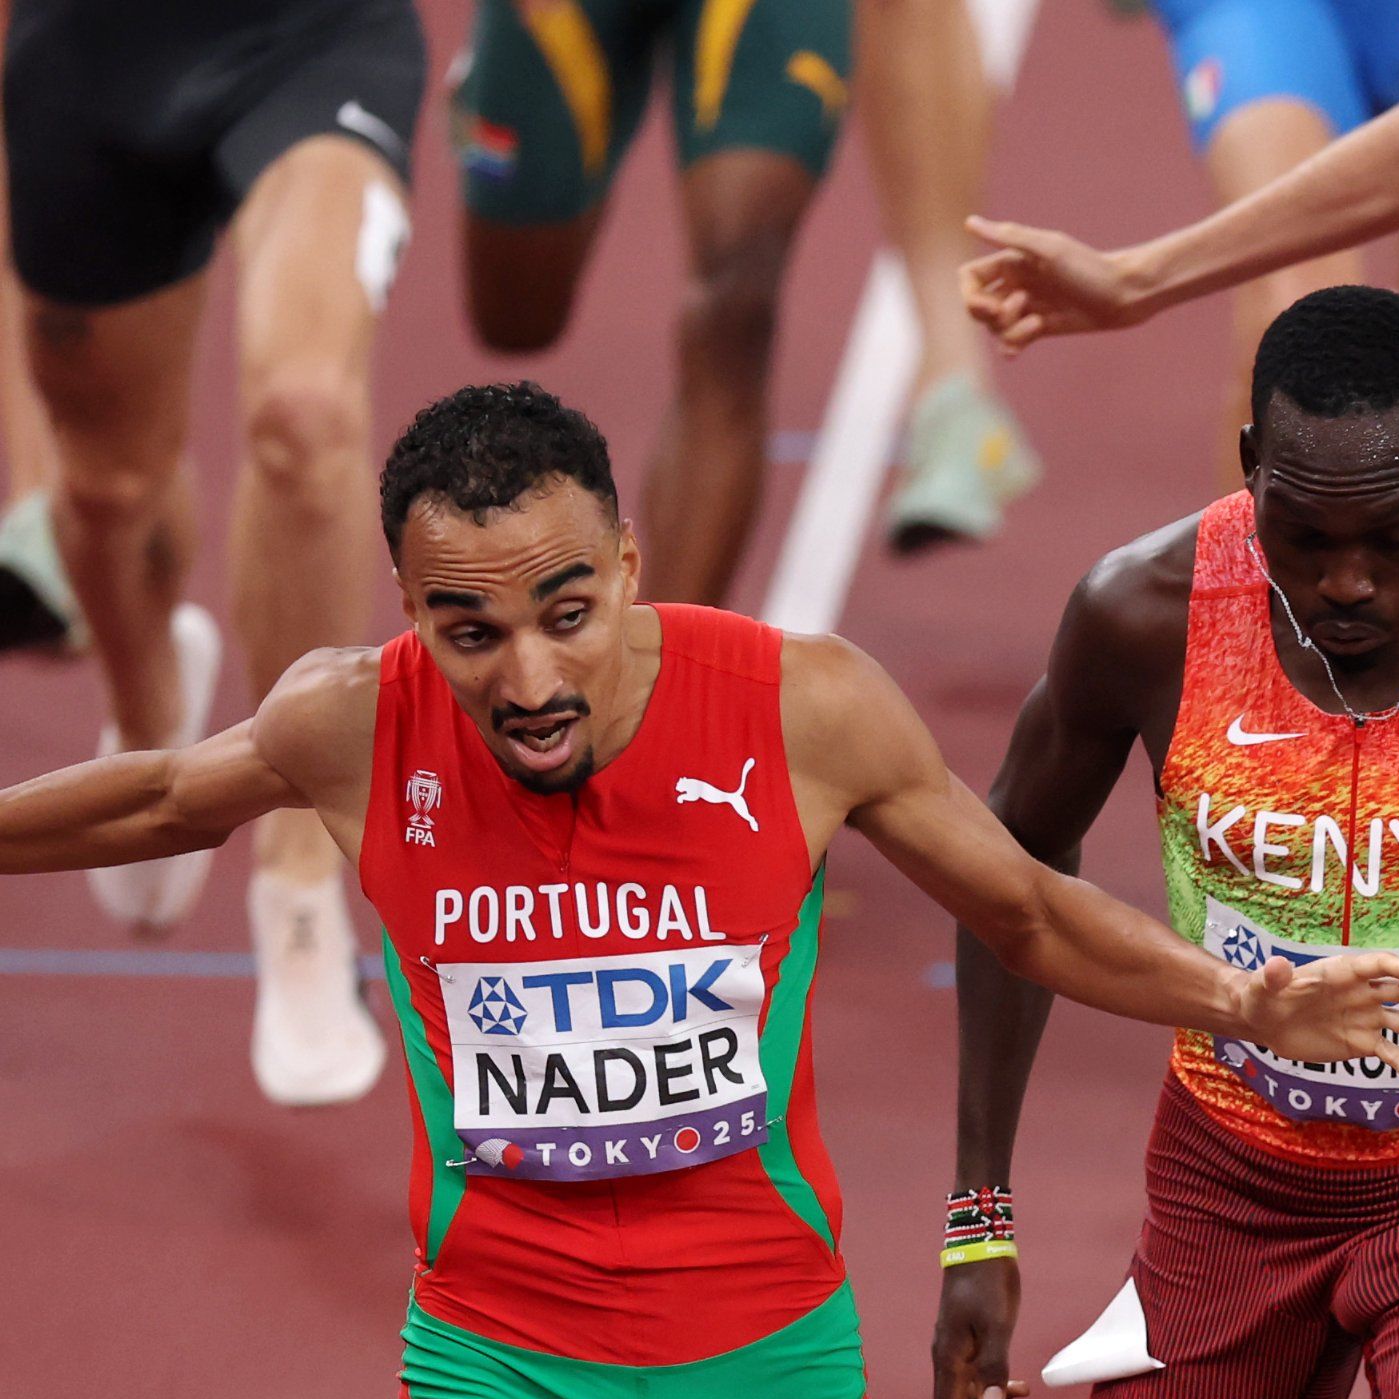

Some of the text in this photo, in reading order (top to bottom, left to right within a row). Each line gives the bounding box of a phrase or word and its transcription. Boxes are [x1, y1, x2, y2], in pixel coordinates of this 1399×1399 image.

[405, 826, 436, 848] FPA
[434, 882, 727, 946] PORTUGAL
[522, 957, 735, 1033] TDK
[475, 1026, 744, 1116] NADER
[713, 1110, 756, 1147] 25
